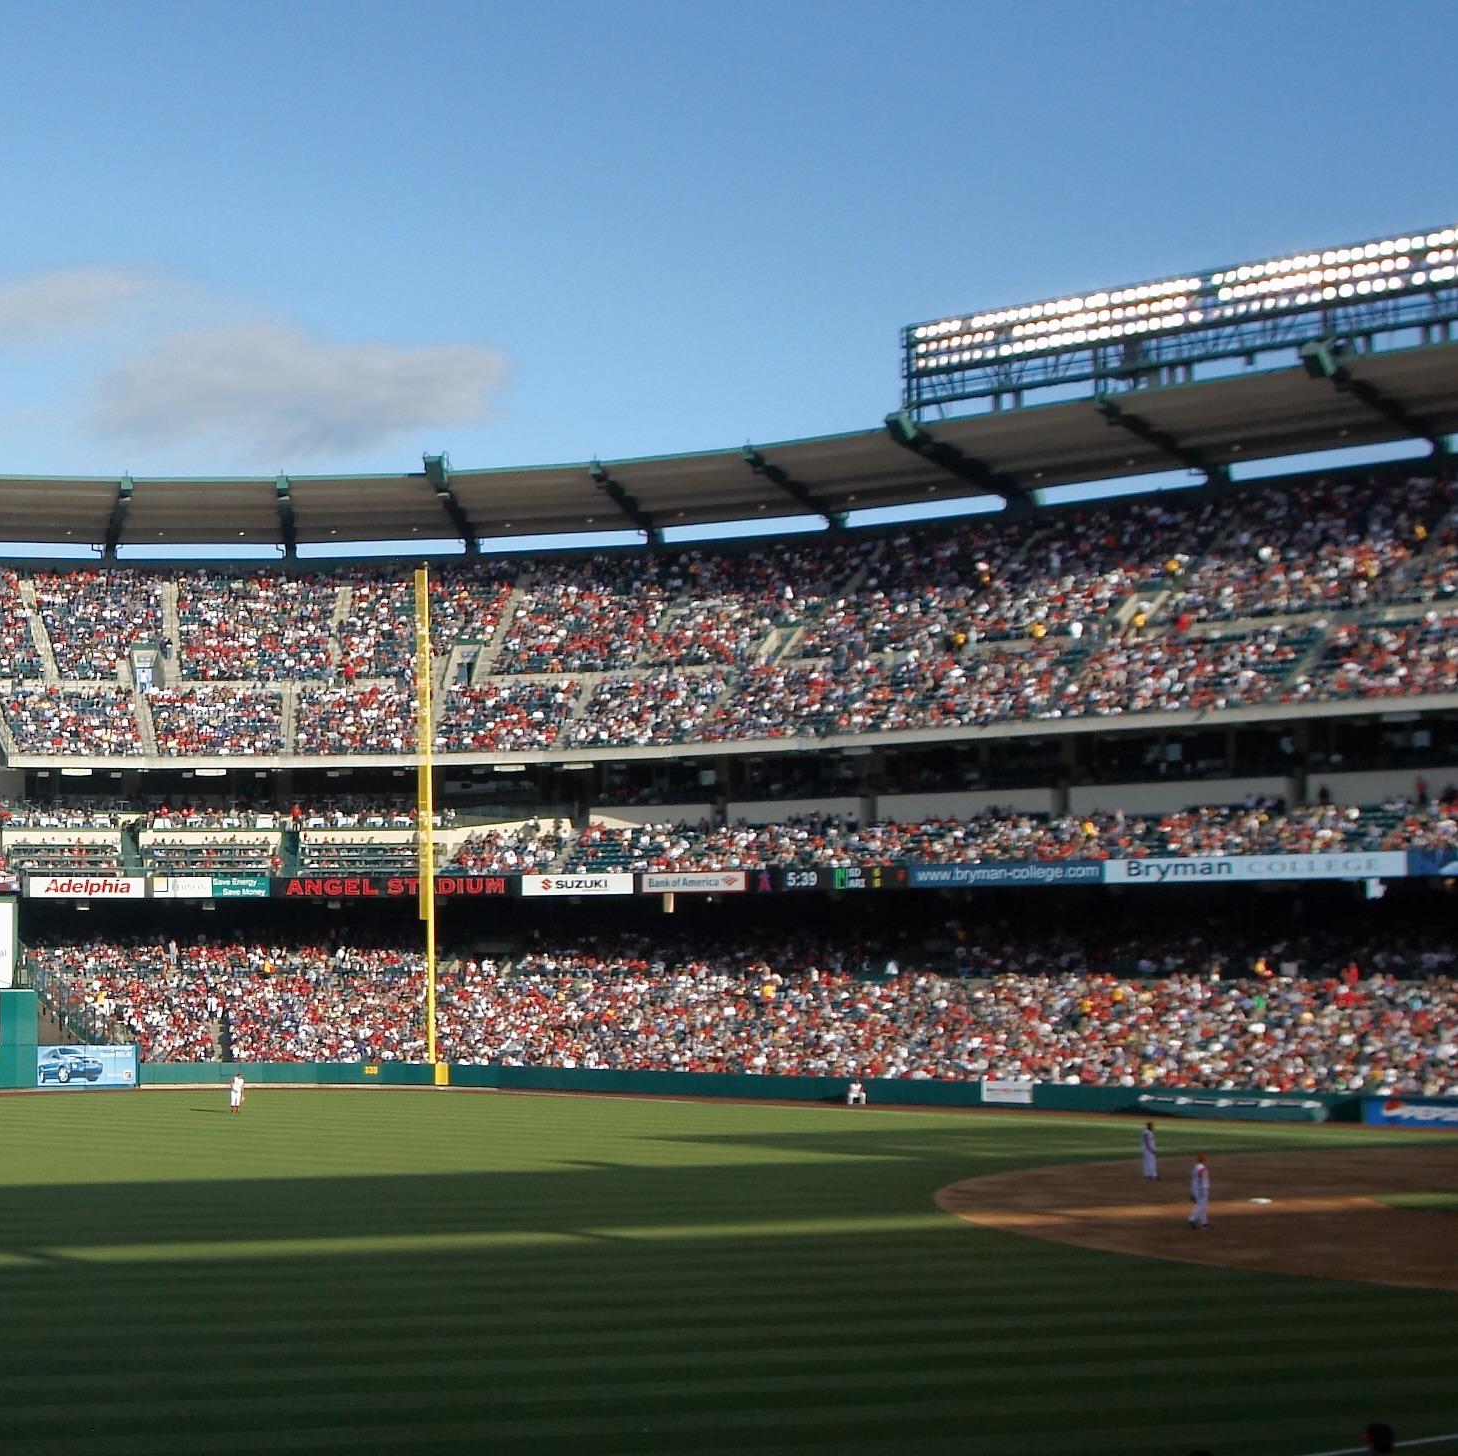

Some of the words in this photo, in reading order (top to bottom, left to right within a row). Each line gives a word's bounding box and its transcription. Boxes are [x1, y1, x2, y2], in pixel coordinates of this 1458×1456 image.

[917, 864, 1099, 886] www.bryman-college.com
[1127, 860, 1232, 882] Bryman
[1246, 858, 1384, 874] COLLEGE
[45, 877, 131, 896] Adelphia
[232, 878, 257, 887] Energy
[286, 877, 380, 896] ANGEL
[387, 876, 506, 896] STDIUM
[555, 878, 608, 890] SUZUKI
[648, 877, 671, 889] Bank
[672, 877, 680, 888] of
[681, 876, 720, 888] America
[787, 871, 818, 888] 5:39
[241, 888, 266, 898] Money
